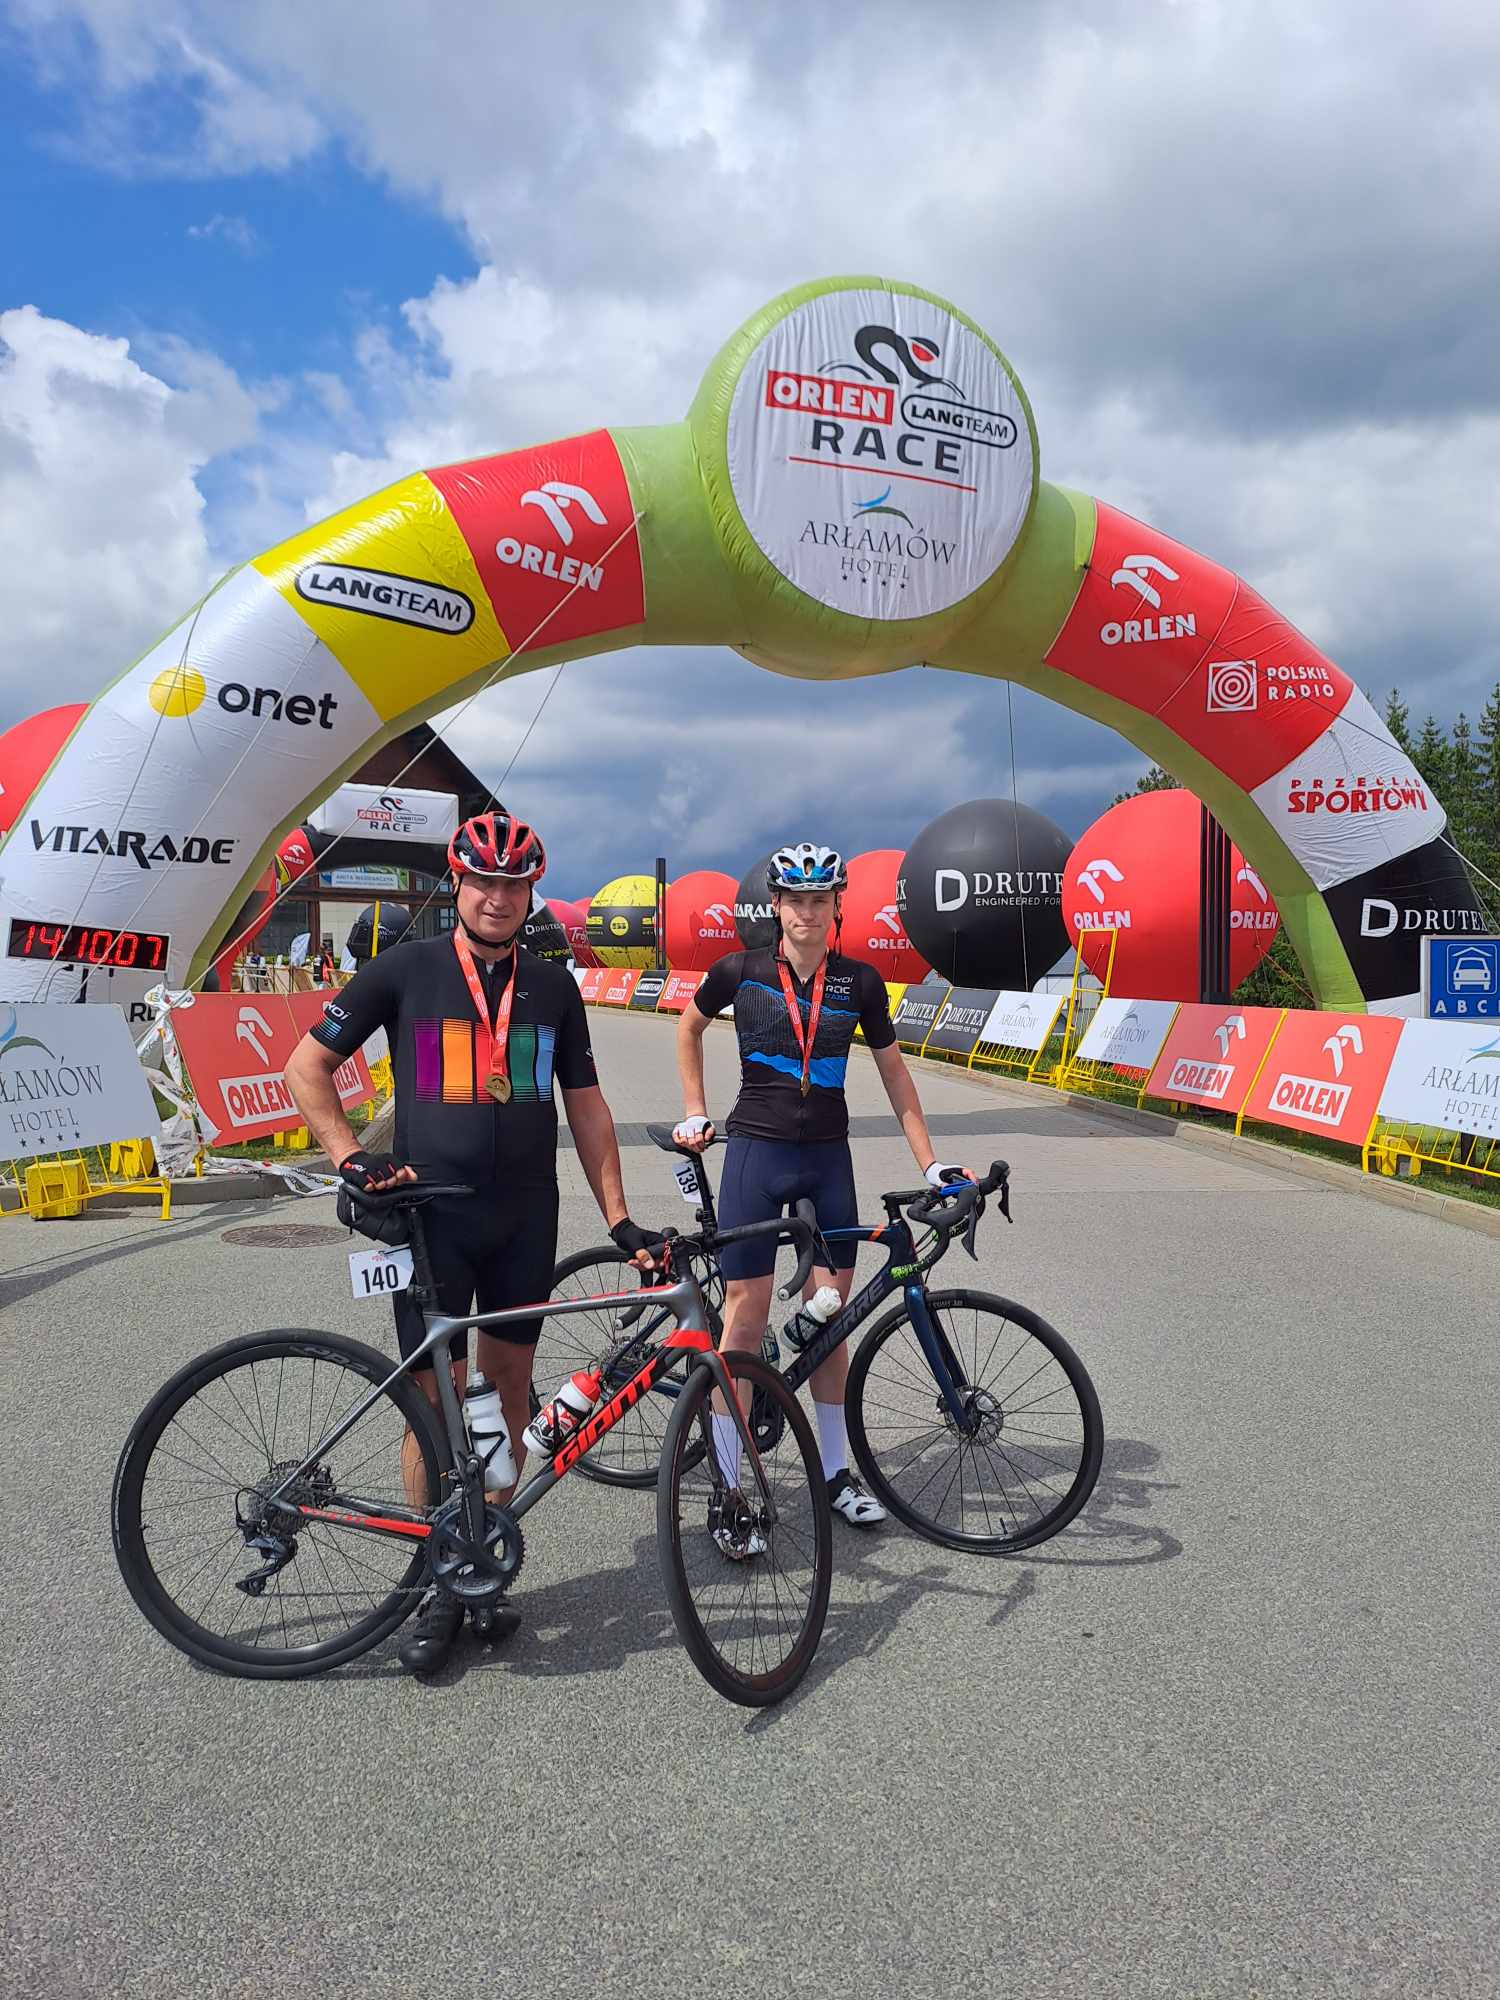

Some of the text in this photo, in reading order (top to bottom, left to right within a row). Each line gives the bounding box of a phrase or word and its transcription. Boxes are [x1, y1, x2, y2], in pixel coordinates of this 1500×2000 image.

[772, 376, 1009, 440] ORLEN LANGTEAM
[811, 419, 961, 475] RACE
[799, 520, 959, 565] ARŁAMÓW
[495, 537, 604, 592] ORLEN
[841, 556, 911, 580] HOTEL
[309, 573, 463, 622] LANGTEAM
[1100, 613, 1196, 646] ORLEN
[1267, 666, 1329, 682] POLSKIE
[217, 680, 338, 730] onet
[1268, 684, 1335, 700] RADIO
[1288, 787, 1428, 814] SPORTOWY
[370, 821, 411, 833] RACE
[31, 819, 235, 870] VITARADE
[975, 897, 1041, 907] ENGINEERED
[699, 927, 735, 940] ORLEN
[1073, 910, 1131, 929] ORLEN
[1230, 911, 1278, 930] ORLEN
[904, 1002, 939, 1020] DRUTEX
[948, 1007, 988, 1026] DRUTEX
[1173, 1063, 1230, 1093] ORLEN
[227, 1079, 293, 1119] ORLEN
[1276, 1079, 1345, 1119] ORLEN
[1444, 1098, 1499, 1121] HOTEL
[10, 1106, 80, 1134] HOTEL
[676, 1166, 699, 1194] 139
[361, 1264, 399, 1293] 140
[553, 1357, 657, 1480] GIANT
